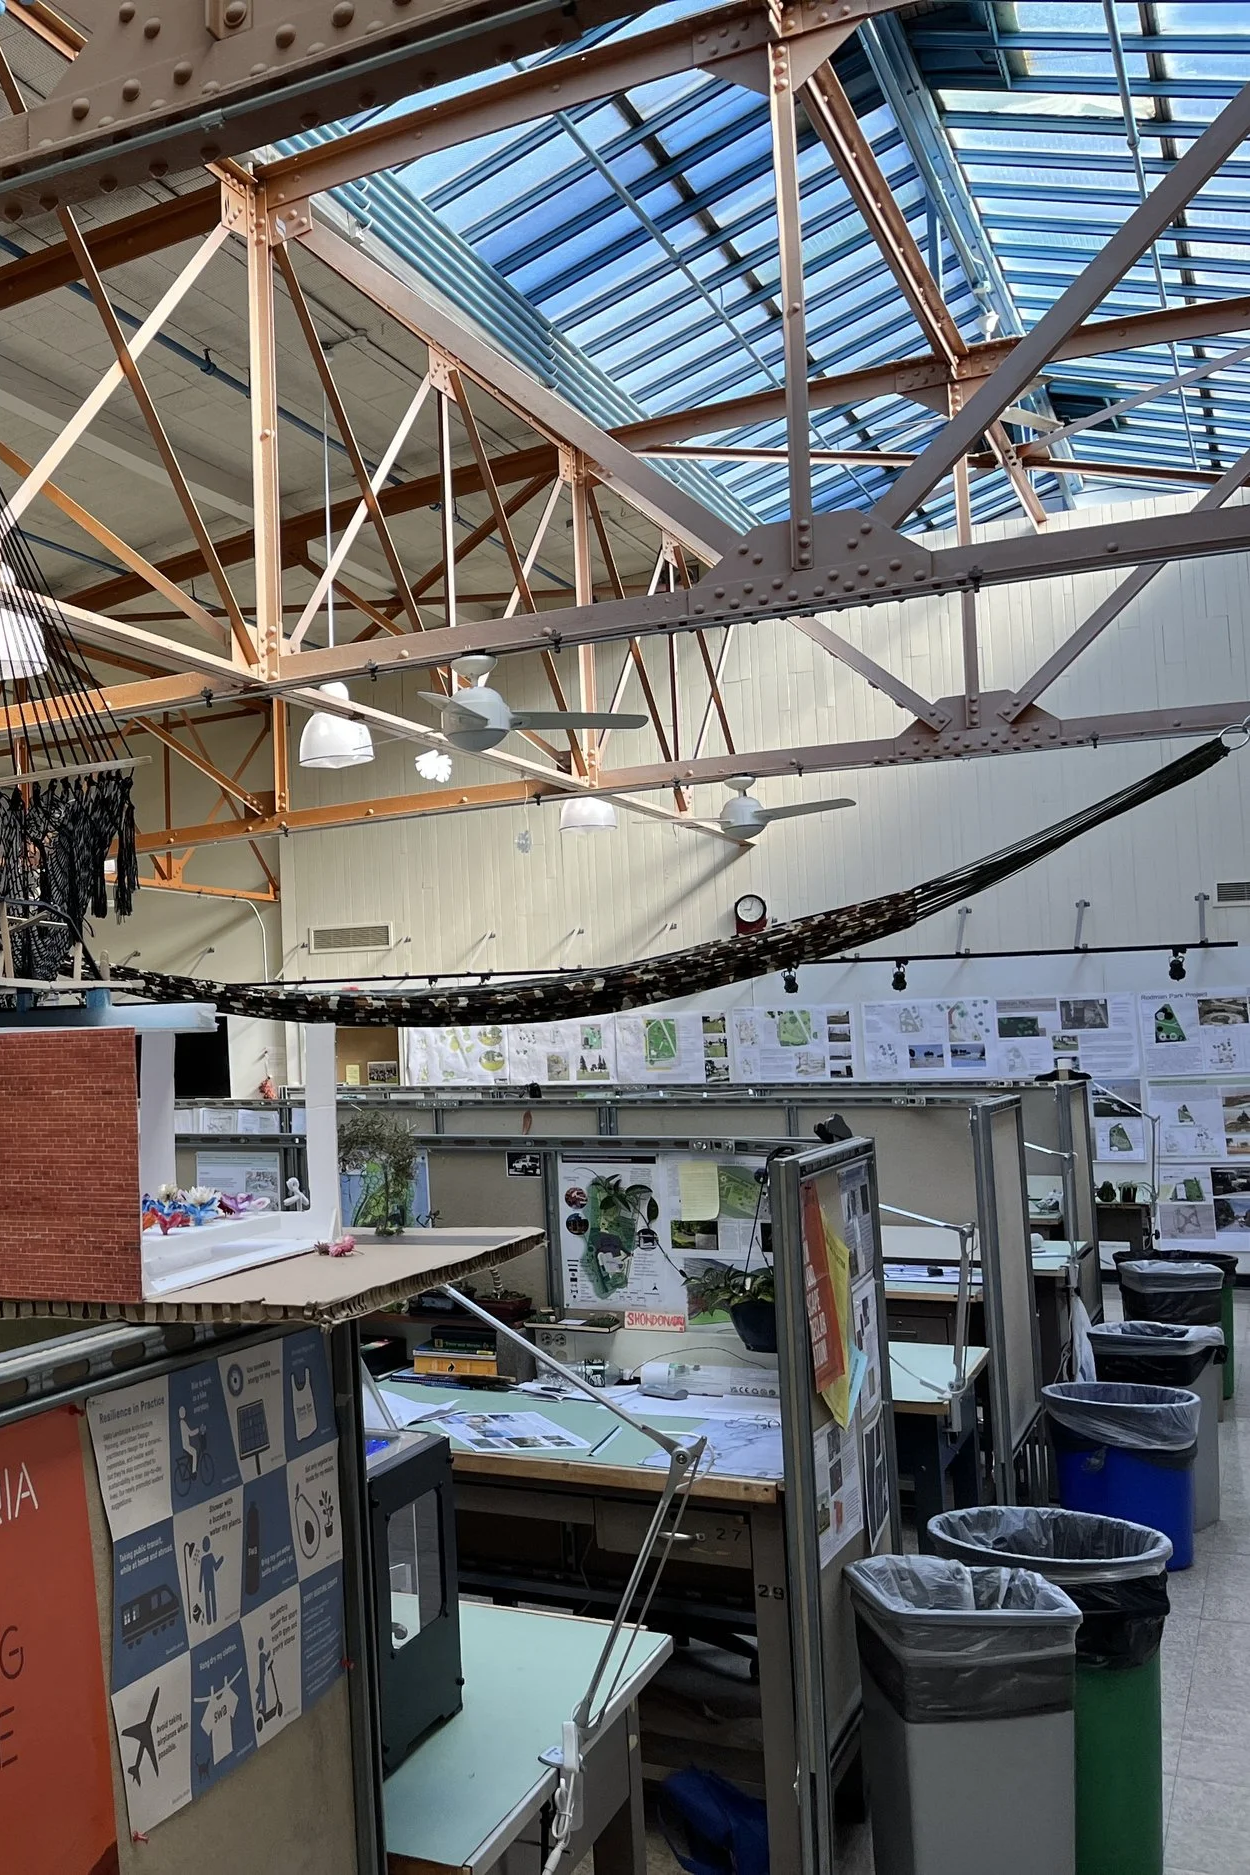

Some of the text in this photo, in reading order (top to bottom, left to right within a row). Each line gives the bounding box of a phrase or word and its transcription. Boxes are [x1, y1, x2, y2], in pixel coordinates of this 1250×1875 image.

[99, 1396, 165, 1424] Resilience in Practice
[209, 1497, 233, 1513] Shower with
[213, 1513, 225, 1524] bucket
[226, 1510, 231, 1518] to
[210, 1526, 222, 1537] water
[222, 1523, 228, 1533] my
[119, 1549, 134, 1563] Taking
[134, 1543, 147, 1560] public
[120, 1562, 132, 1576] while
[137, 1557, 150, 1568] home
[150, 1551, 158, 1562] and
[757, 1584, 785, 1601] 29
[200, 1658, 210, 1672] Hang
[217, 1652, 223, 1662] my
[156, 1713, 182, 1734] Avoid taking
[158, 1722, 189, 1747] airplanes when
[158, 1743, 177, 1761] possible.
